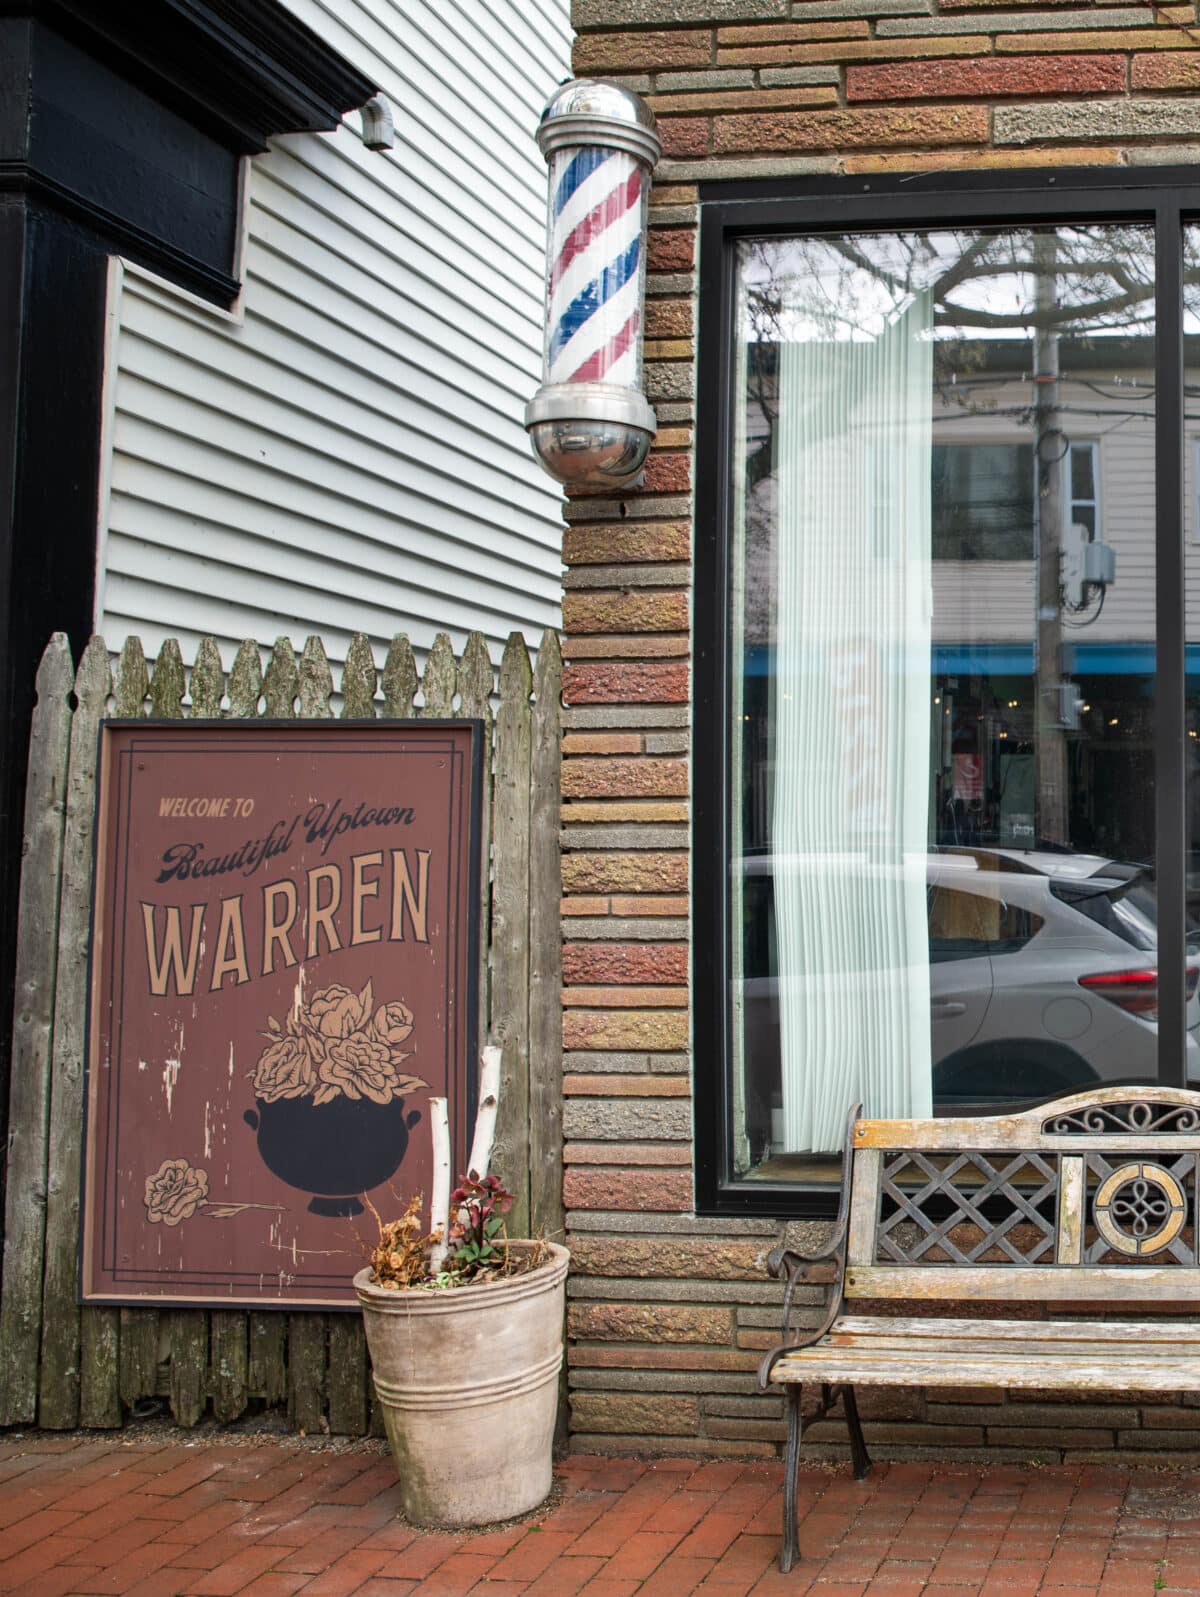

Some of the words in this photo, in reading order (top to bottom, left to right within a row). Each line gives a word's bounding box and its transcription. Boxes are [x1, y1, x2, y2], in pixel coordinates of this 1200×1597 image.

[155, 815, 300, 884] Beautiful
[304, 799, 416, 856] Uptown
[158, 797, 230, 818] WELCOME
[232, 798, 255, 818] TO
[139, 848, 432, 996] WARREN
